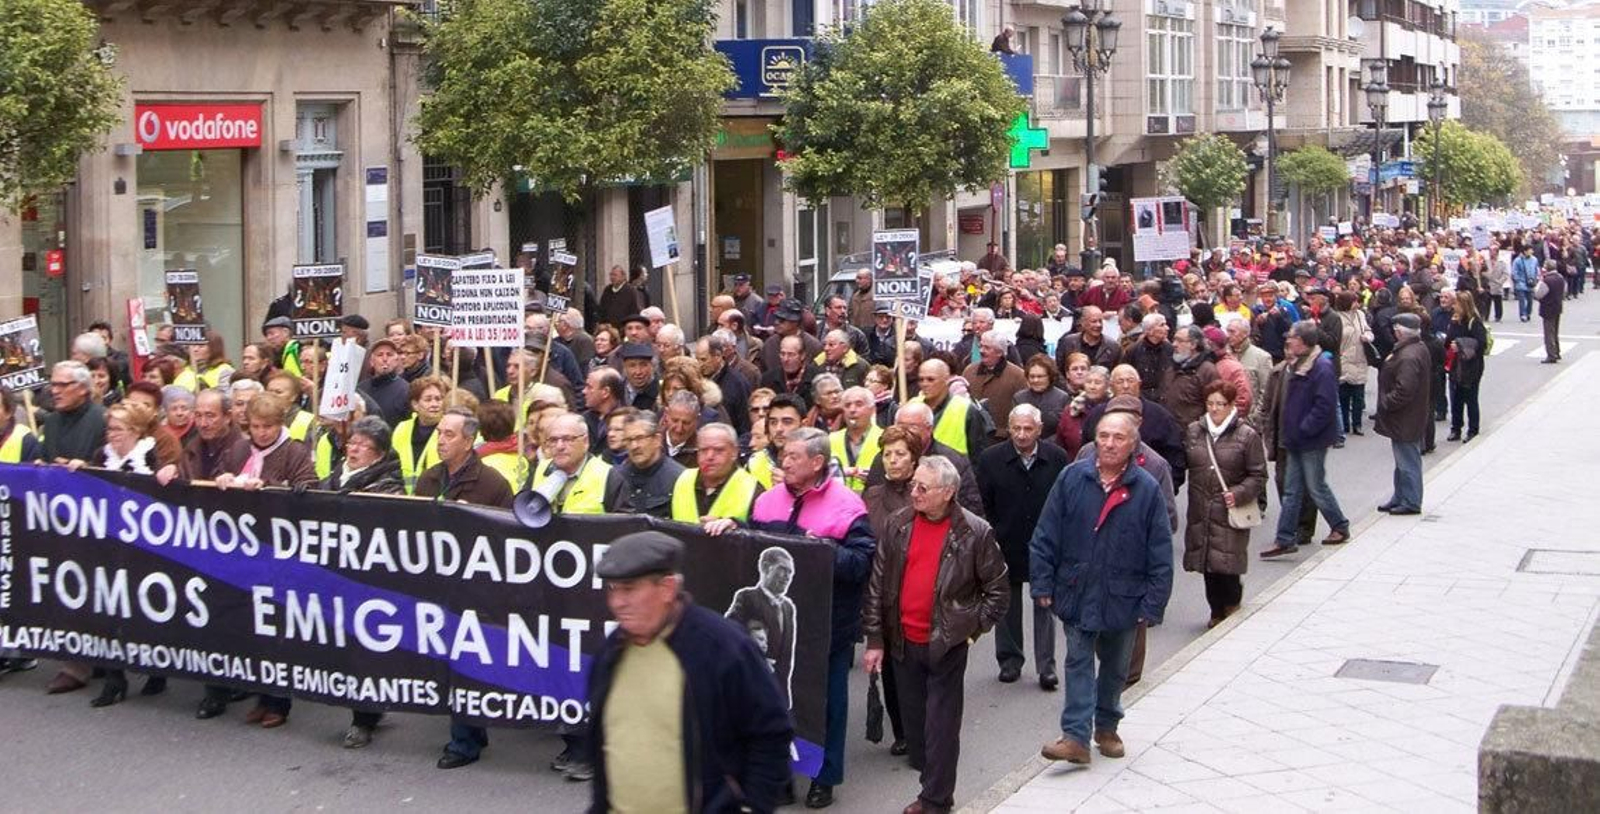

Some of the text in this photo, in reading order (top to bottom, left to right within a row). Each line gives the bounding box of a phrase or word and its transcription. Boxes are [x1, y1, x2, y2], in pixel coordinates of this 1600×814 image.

[165, 113, 258, 140] vodafone
[877, 281, 917, 294] NON.
[295, 320, 341, 335] NON.
[417, 306, 452, 321] NON
[0, 485, 13, 609] OURENSE
[26, 491, 108, 539] NON
[119, 500, 260, 557] SOMOS
[30, 556, 620, 673] FOMOS EMIGRANT
[126, 642, 256, 682] PROVINCIAL
[260, 660, 288, 687] DE
[293, 665, 440, 707] EMIGRANTES
